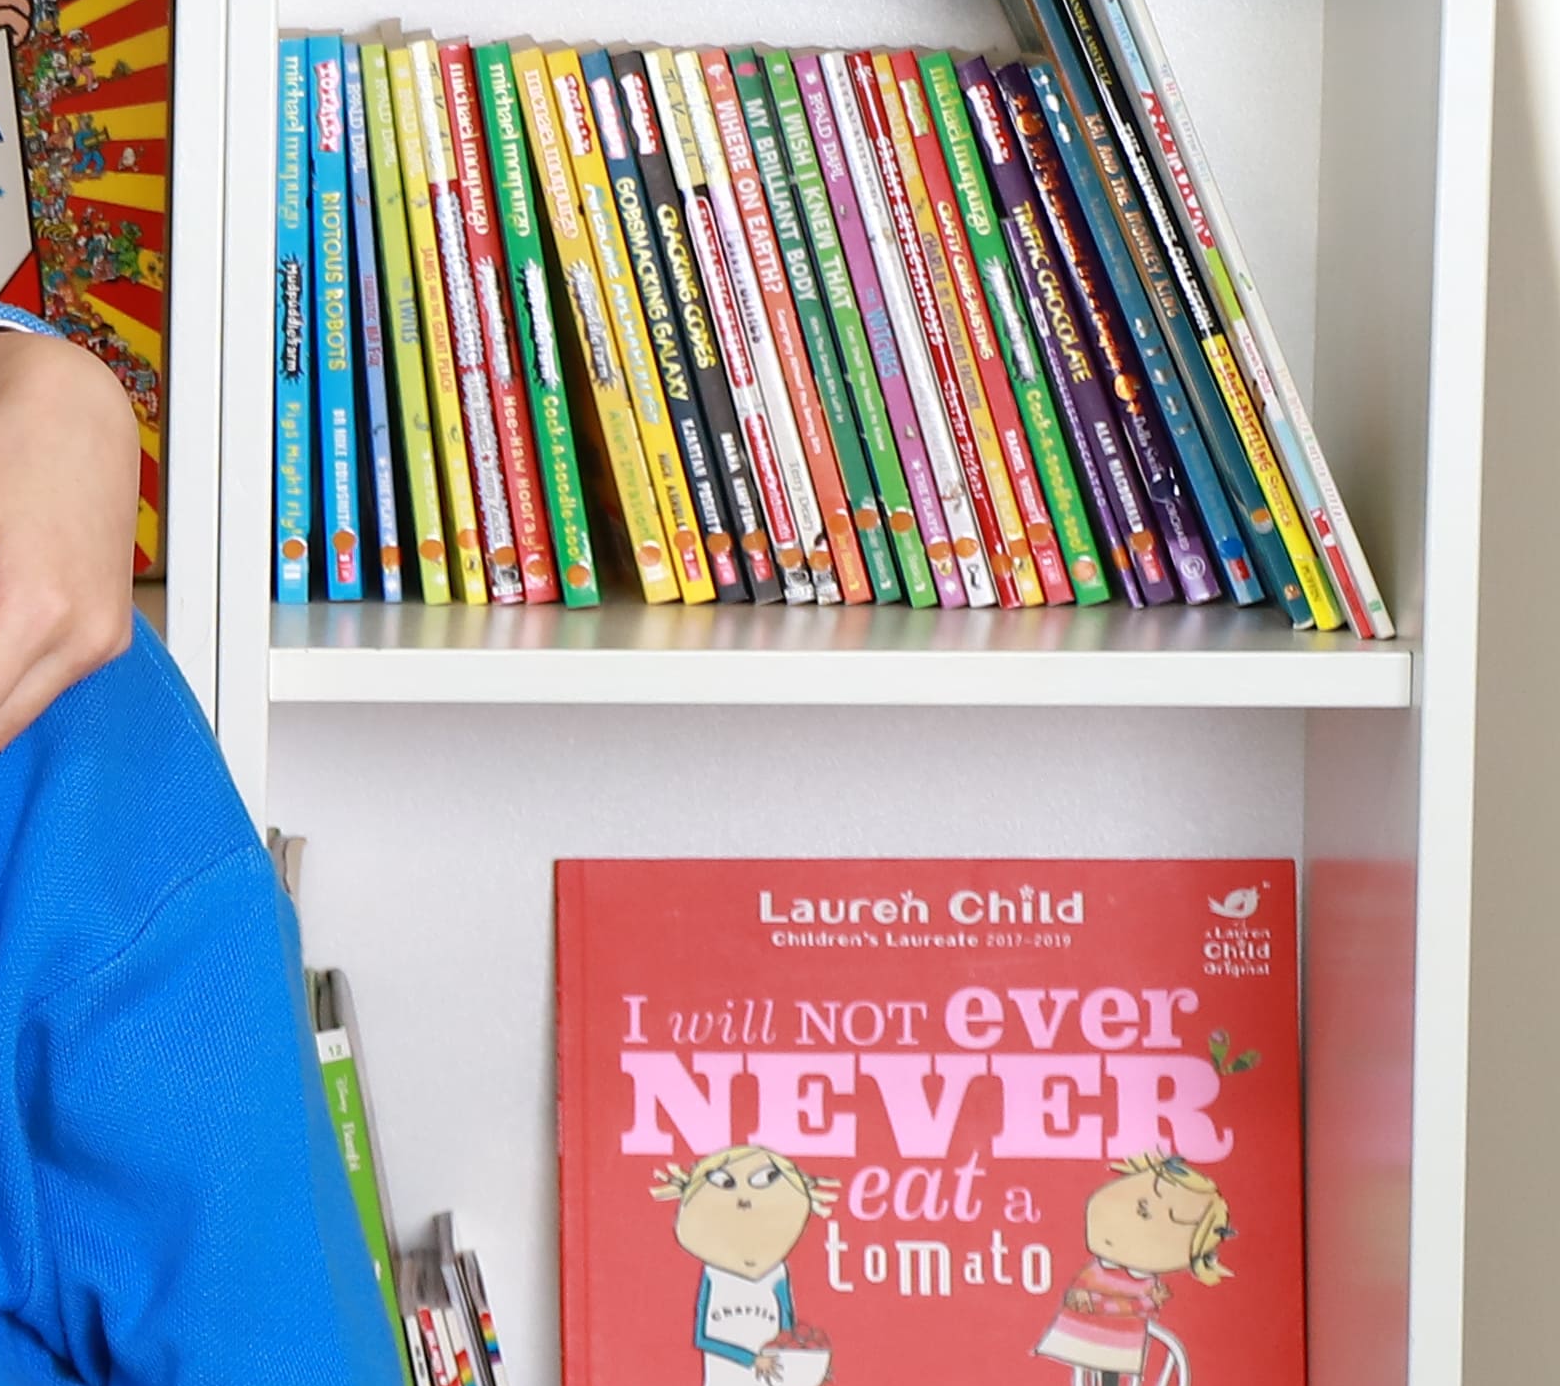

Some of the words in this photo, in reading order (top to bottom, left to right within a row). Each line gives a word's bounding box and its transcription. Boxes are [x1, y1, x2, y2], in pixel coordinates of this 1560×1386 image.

[491, 64, 517, 141] michael
[498, 144, 531, 236] morpurgo
[716, 100, 745, 173] WHERE
[746, 217, 782, 294] EARTH?
[752, 137, 795, 242] BRILLIANT
[786, 249, 817, 304] BODY
[322, 192, 343, 284] RIOTOUS
[802, 186, 834, 250] KNEW
[824, 256, 852, 309] THAT
[325, 290, 347, 371] ROBOTS
[615, 177, 665, 320] GOBSMACKING
[650, 323, 690, 402] GALAXY
[657, 204, 699, 302] CRACKING
[684, 305, 716, 369] CODES
[1013, 202, 1053, 267] TRIFFIC
[1038, 271, 1092, 385] CHOCOLATE
[760, 889, 929, 924] Lauren
[949, 884, 1084, 924] Child
[771, 931, 879, 947] Children's
[886, 931, 979, 947] Laureate
[986, 933, 1072, 949] 2017-2019
[1203, 938, 1271, 959] Child
[622, 995, 648, 1044] I
[670, 999, 777, 1044] will
[796, 1002, 927, 1045] NOT
[945, 986, 1198, 1049] ever
[620, 1053, 1233, 1163] NEVER
[848, 1150, 986, 1222] eat
[1004, 1187, 1041, 1223] a
[825, 1220, 1052, 1296] tomato
